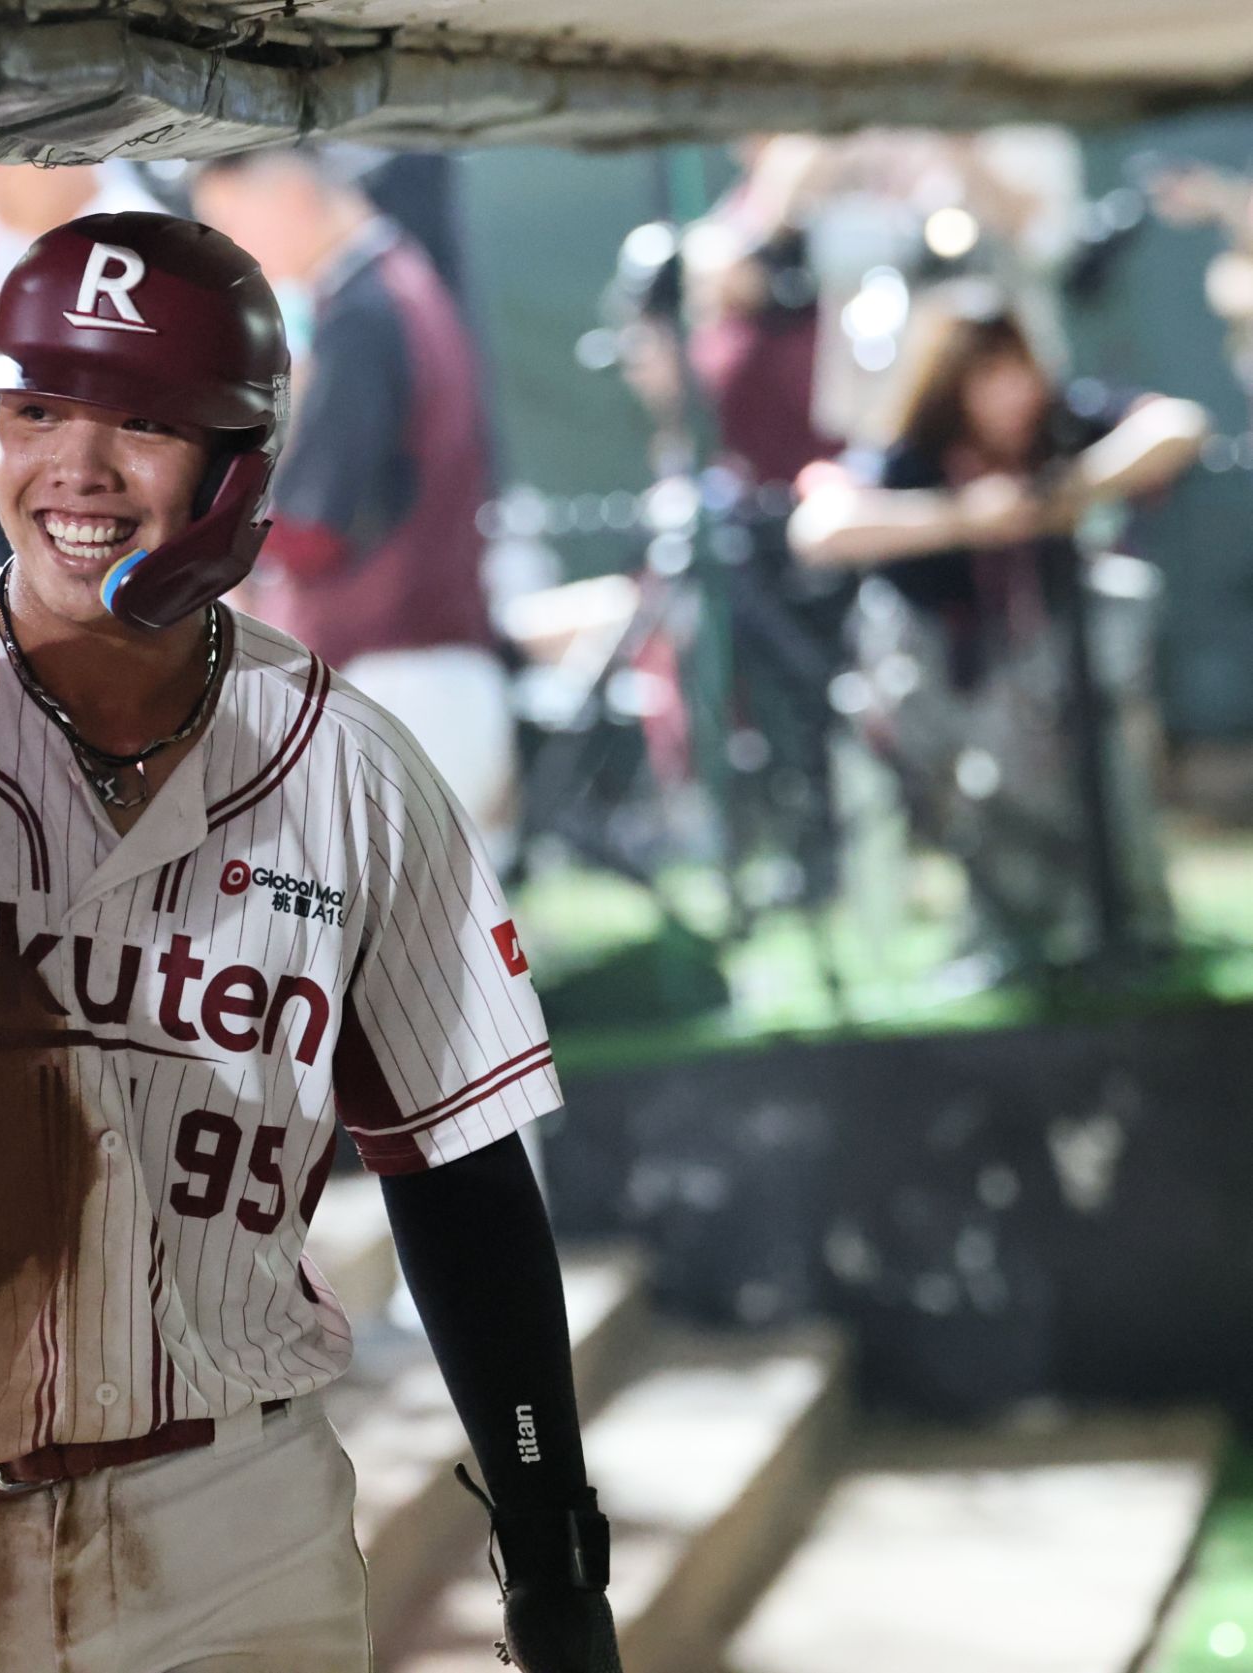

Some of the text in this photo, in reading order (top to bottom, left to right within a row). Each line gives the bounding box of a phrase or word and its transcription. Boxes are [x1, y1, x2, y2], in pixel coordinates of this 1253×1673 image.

[75, 242, 146, 324] R
[251, 867, 346, 906] Global Ma
[169, 1108, 287, 1235] 95
[515, 1405, 541, 1463] titan
